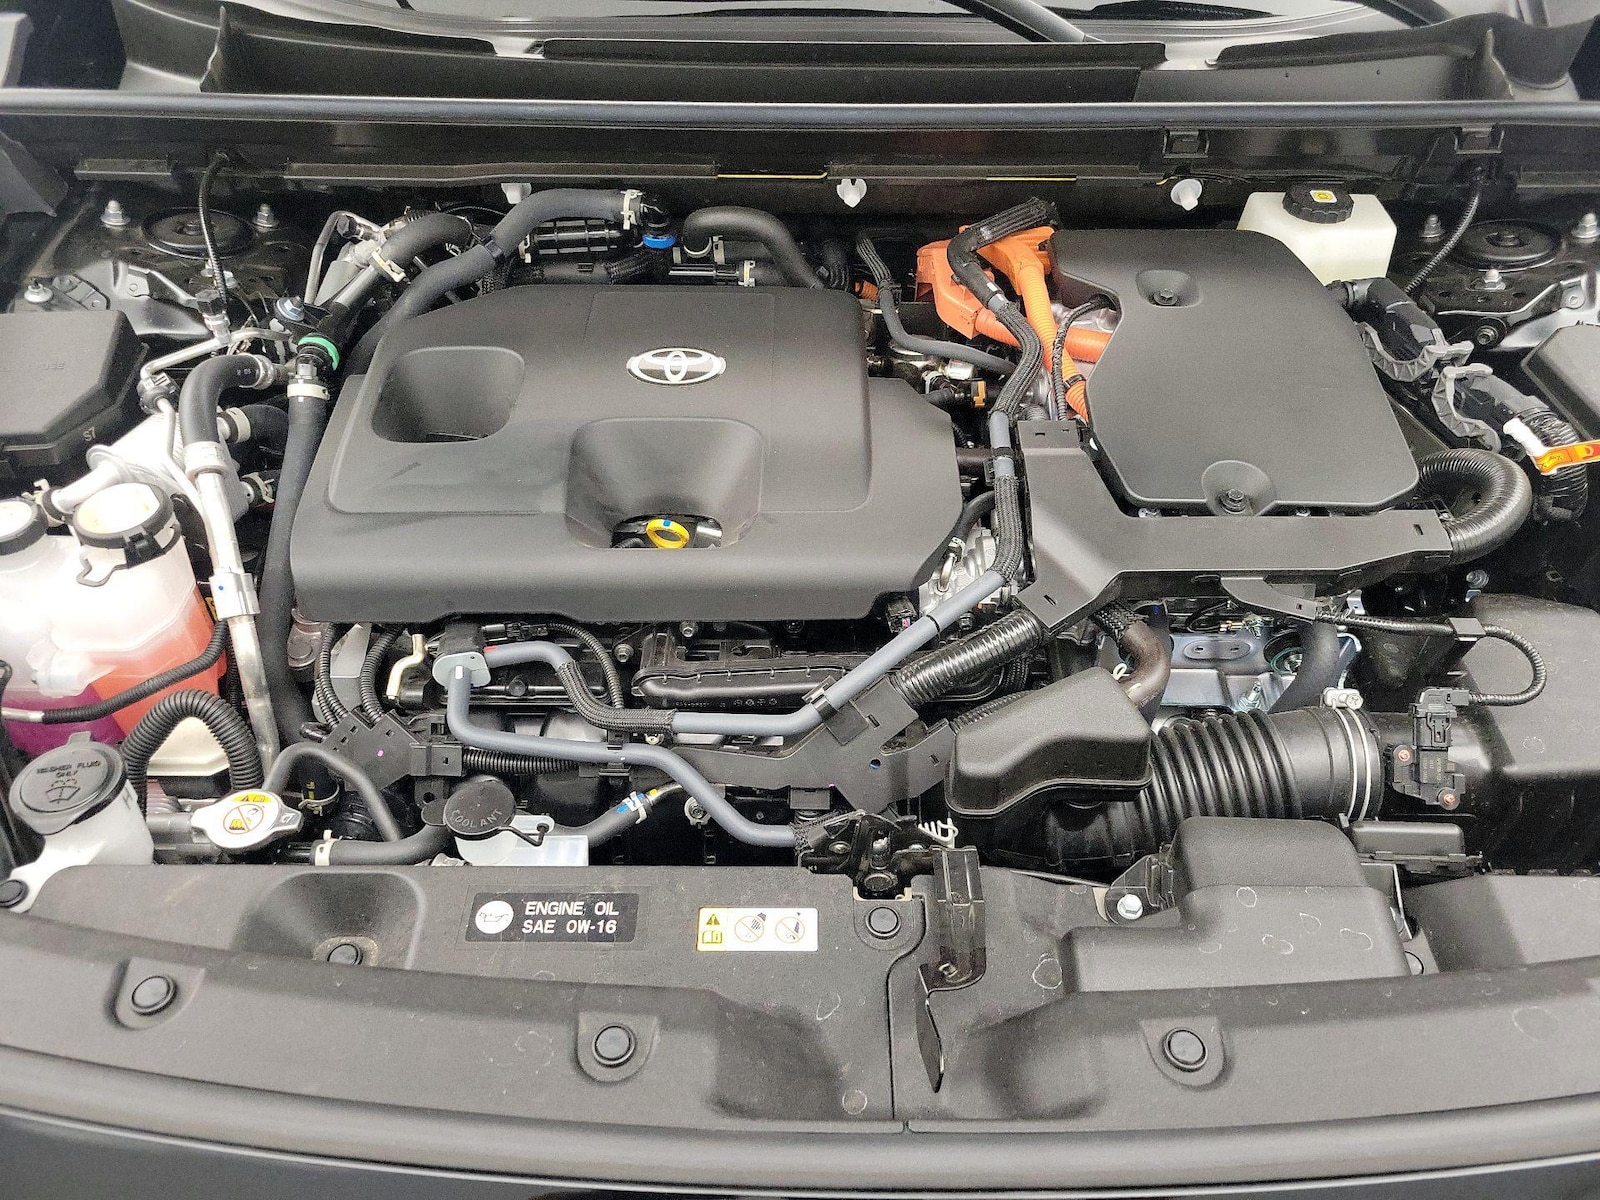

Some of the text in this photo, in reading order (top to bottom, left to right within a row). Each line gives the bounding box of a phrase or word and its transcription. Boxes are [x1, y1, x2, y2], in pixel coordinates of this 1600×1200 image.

[76, 761, 100, 769] FLUID
[451, 809, 503, 827] COOLANT
[525, 901, 619, 916] ENGINE OIL
[522, 919, 556, 934] SAE
